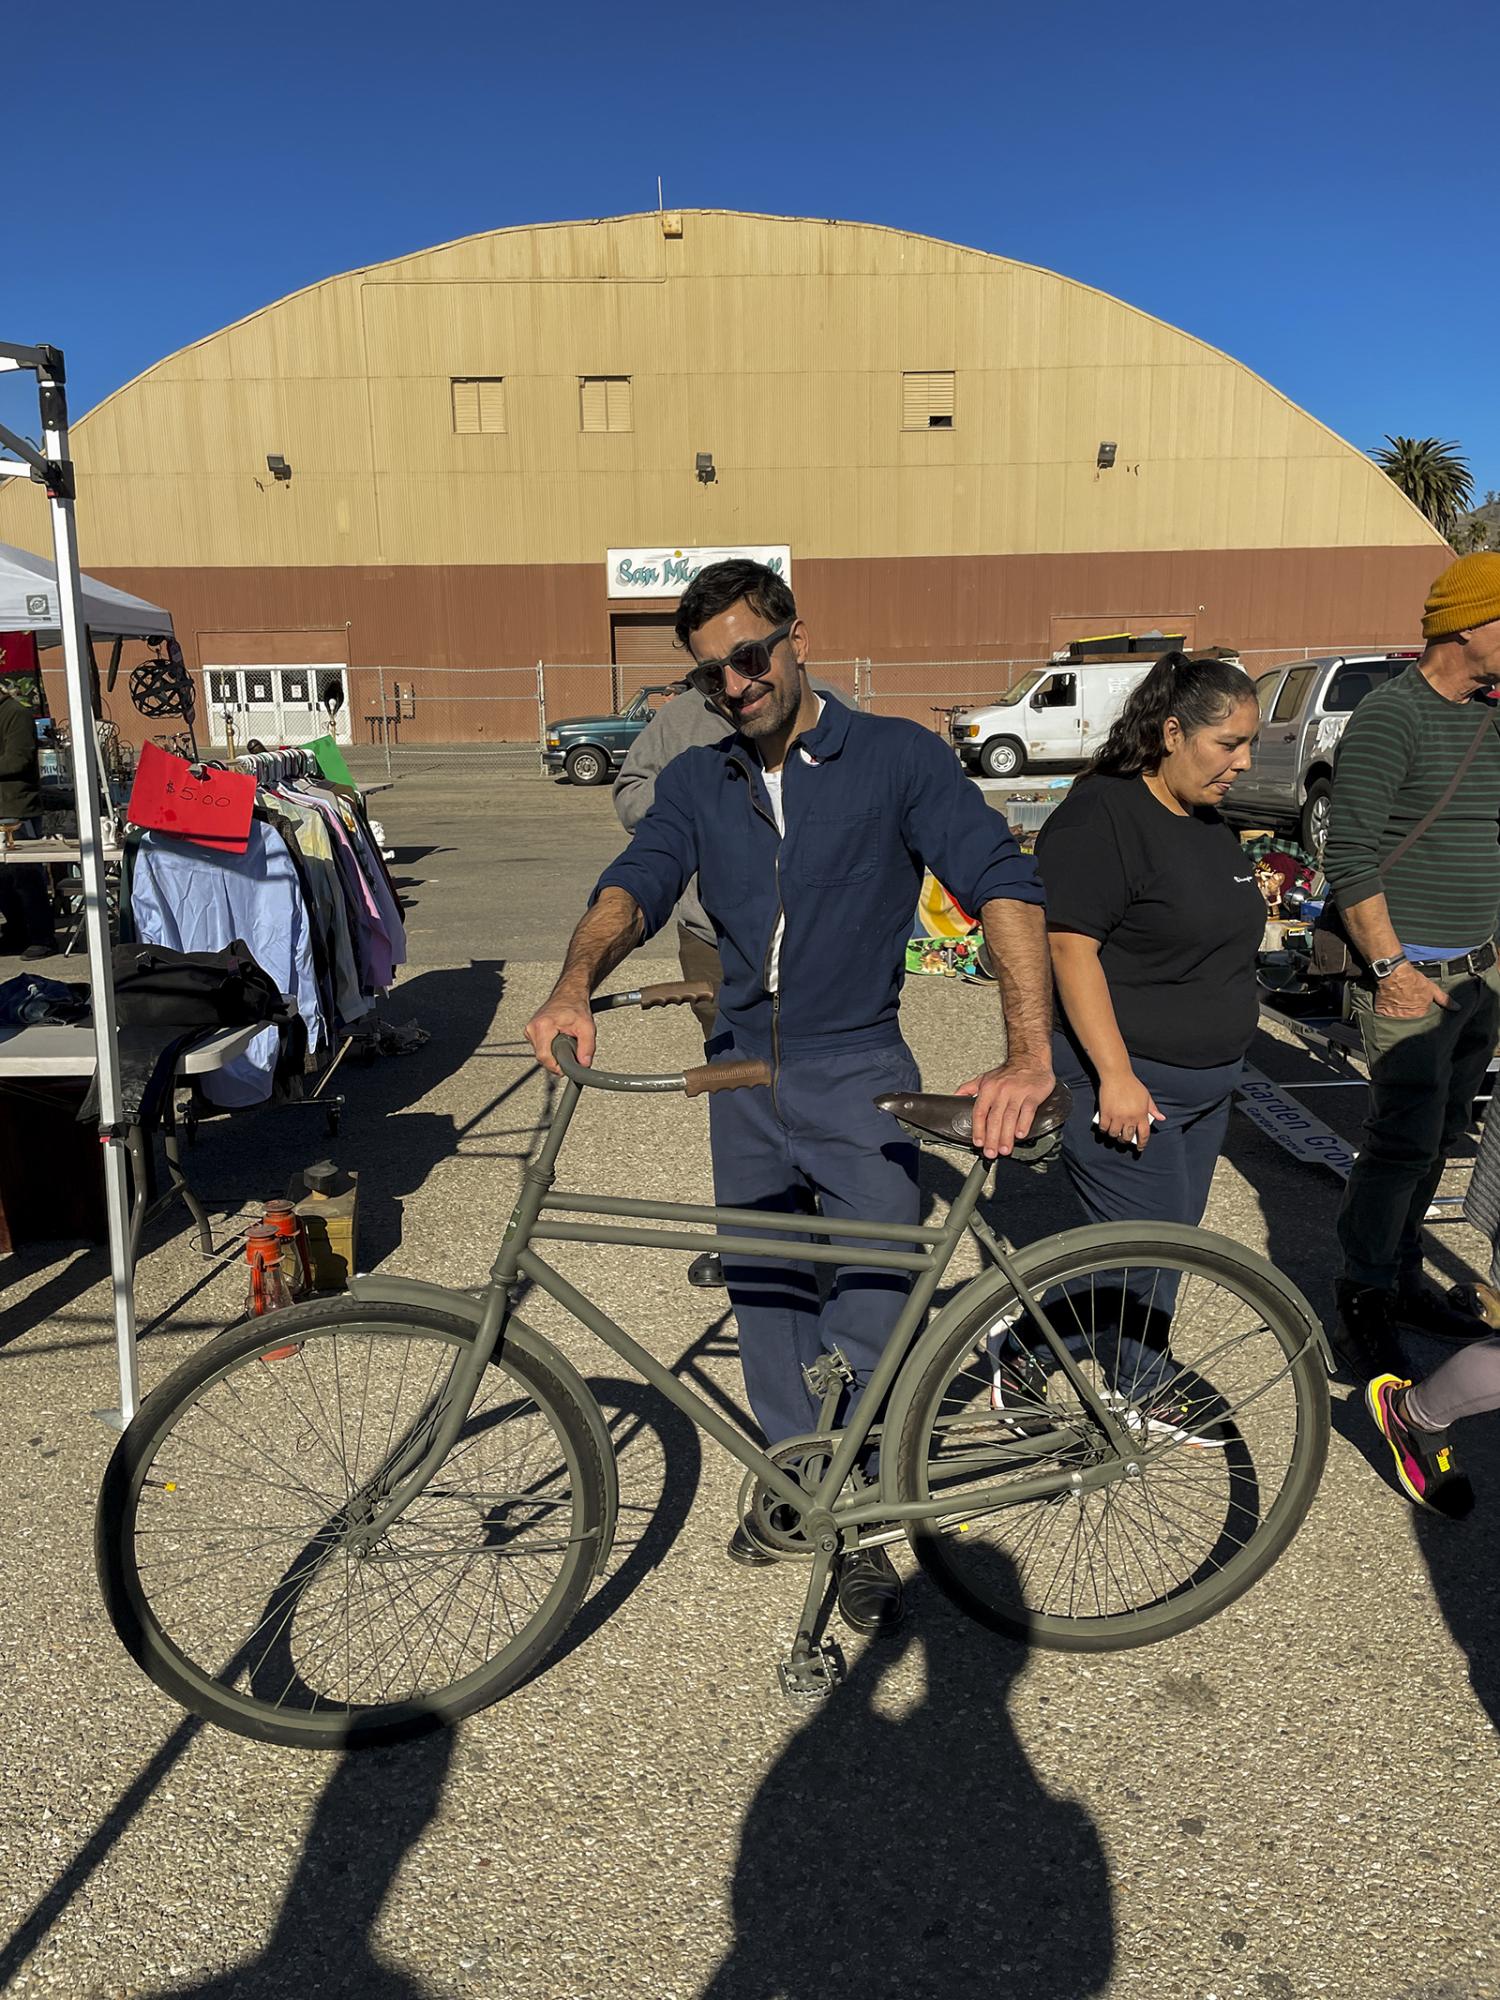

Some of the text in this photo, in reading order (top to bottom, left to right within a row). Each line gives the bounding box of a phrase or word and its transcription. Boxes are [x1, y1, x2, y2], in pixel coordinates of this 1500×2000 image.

[616, 558, 660, 587] San
[1241, 1082, 1356, 1176] Garden Grov
[1246, 1106, 1306, 1154] Garden Grove
